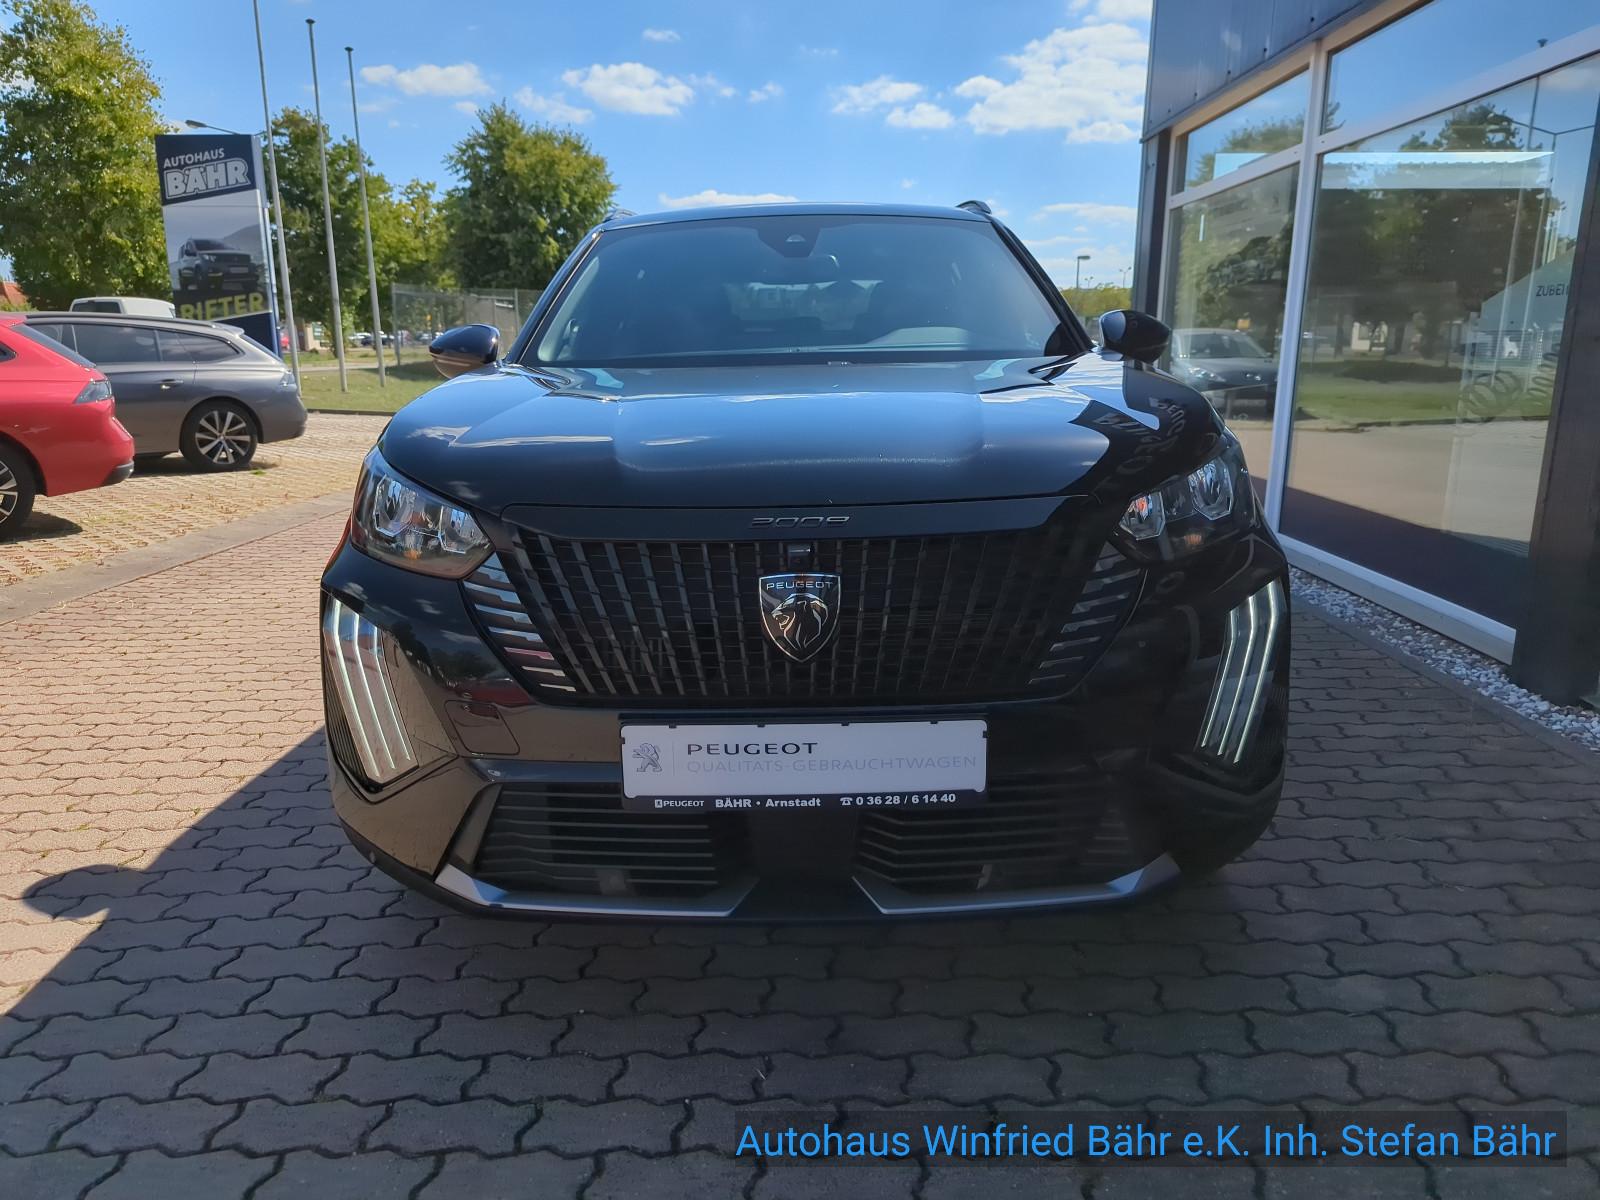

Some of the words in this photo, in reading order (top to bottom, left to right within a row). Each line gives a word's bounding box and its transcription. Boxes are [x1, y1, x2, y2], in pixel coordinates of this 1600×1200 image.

[163, 148, 226, 168] AUTOHAUS
[164, 158, 250, 199] BÄHR
[180, 292, 264, 321] RIFTER
[752, 515, 850, 529] 2008
[766, 581, 834, 591] PEUGEOT
[686, 742, 819, 756] PEUGEOT
[663, 799, 705, 808] PEUGEOT
[715, 797, 752, 808] BÄHR
[765, 797, 821, 808] Arnstadt
[855, 797, 864, 806] 0
[866, 796, 883, 806] 36
[884, 795, 901, 806] 28
[911, 795, 920, 805] 6
